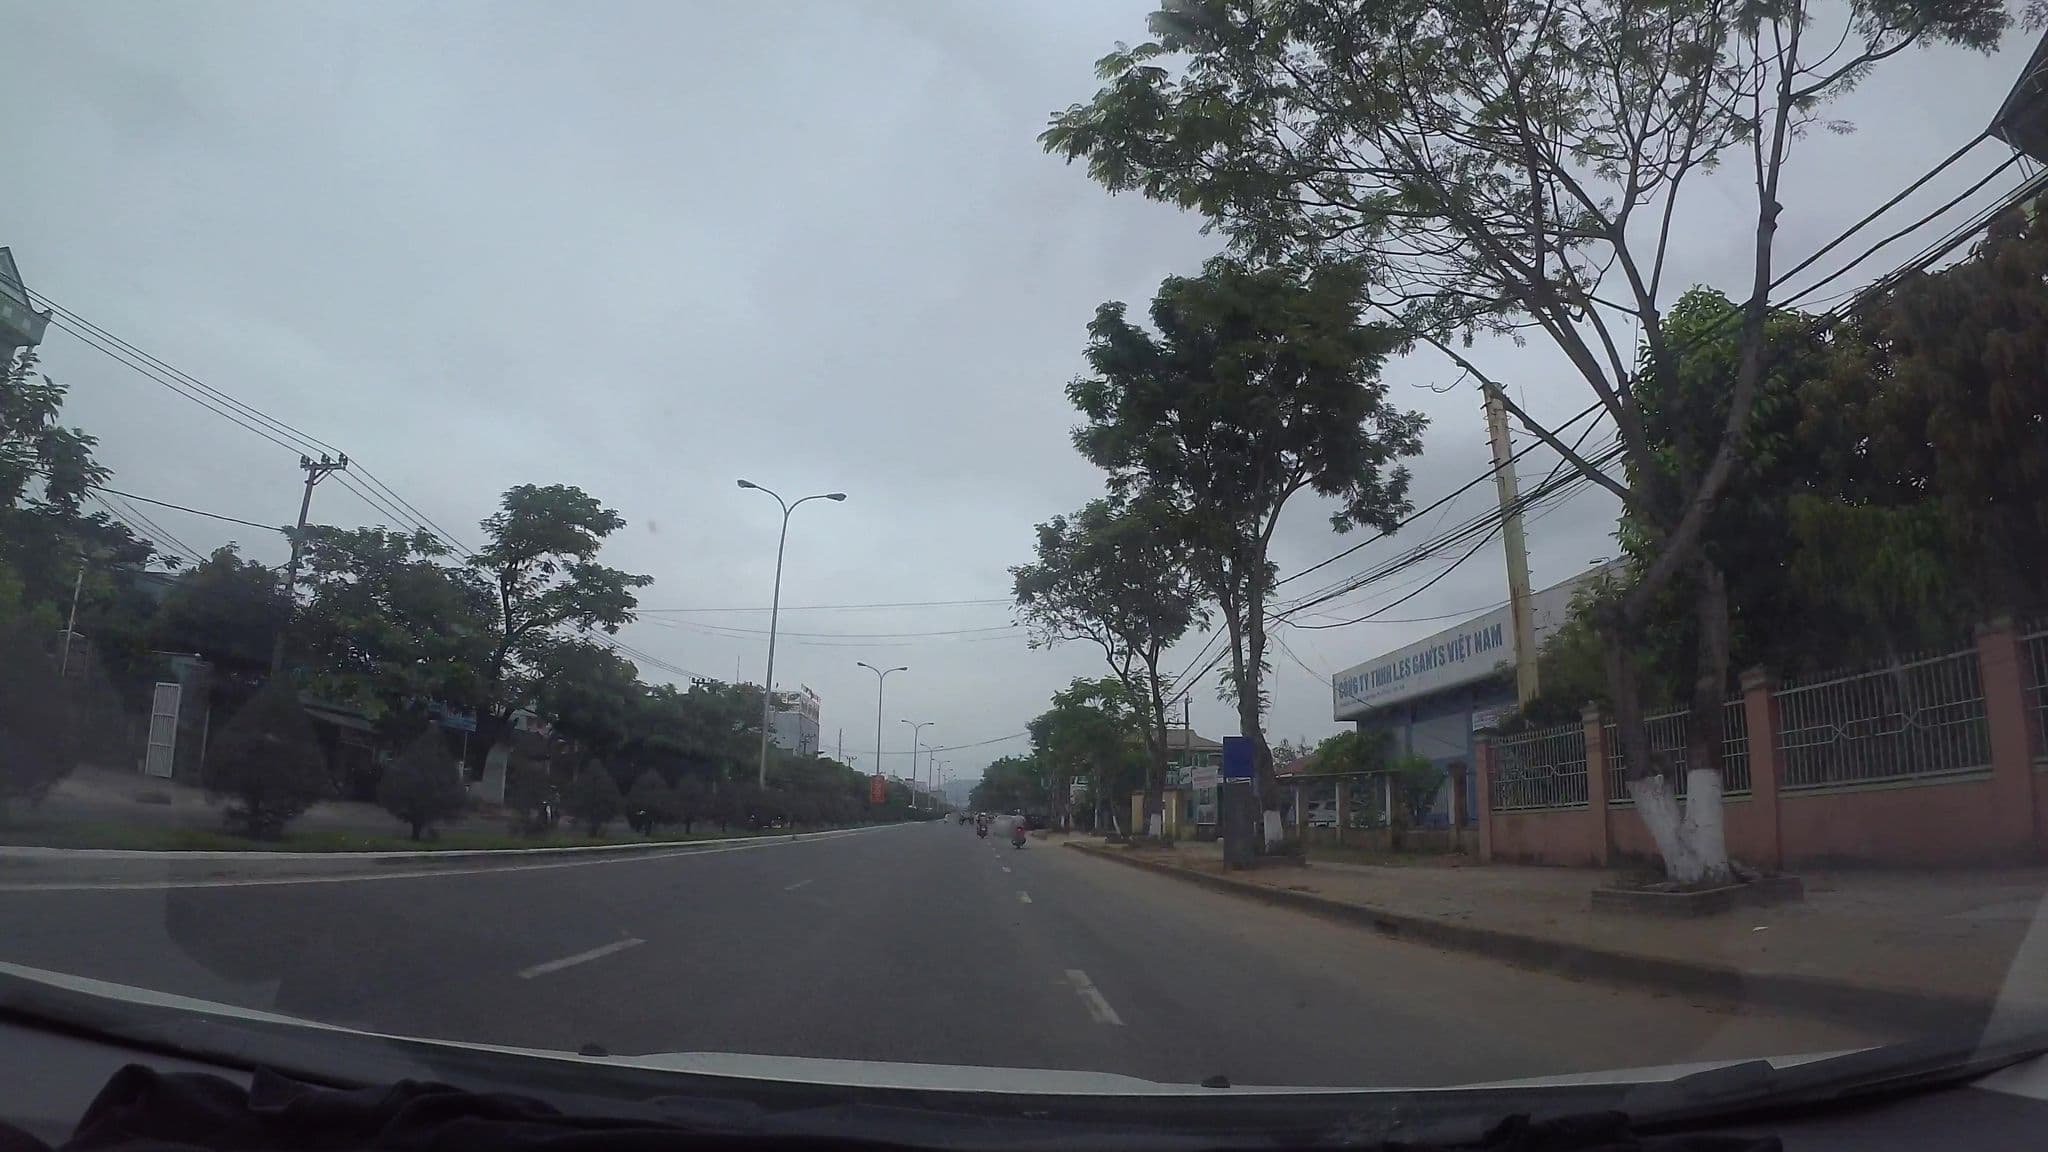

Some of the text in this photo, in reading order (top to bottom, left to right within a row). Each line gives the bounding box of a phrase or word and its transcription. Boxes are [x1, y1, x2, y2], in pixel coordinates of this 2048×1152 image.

[1360, 672, 1369, 692] TY
[1393, 657, 1411, 680] LES
[1447, 633, 1472, 664] VIỆT
[1475, 622, 1502, 653] NAM
